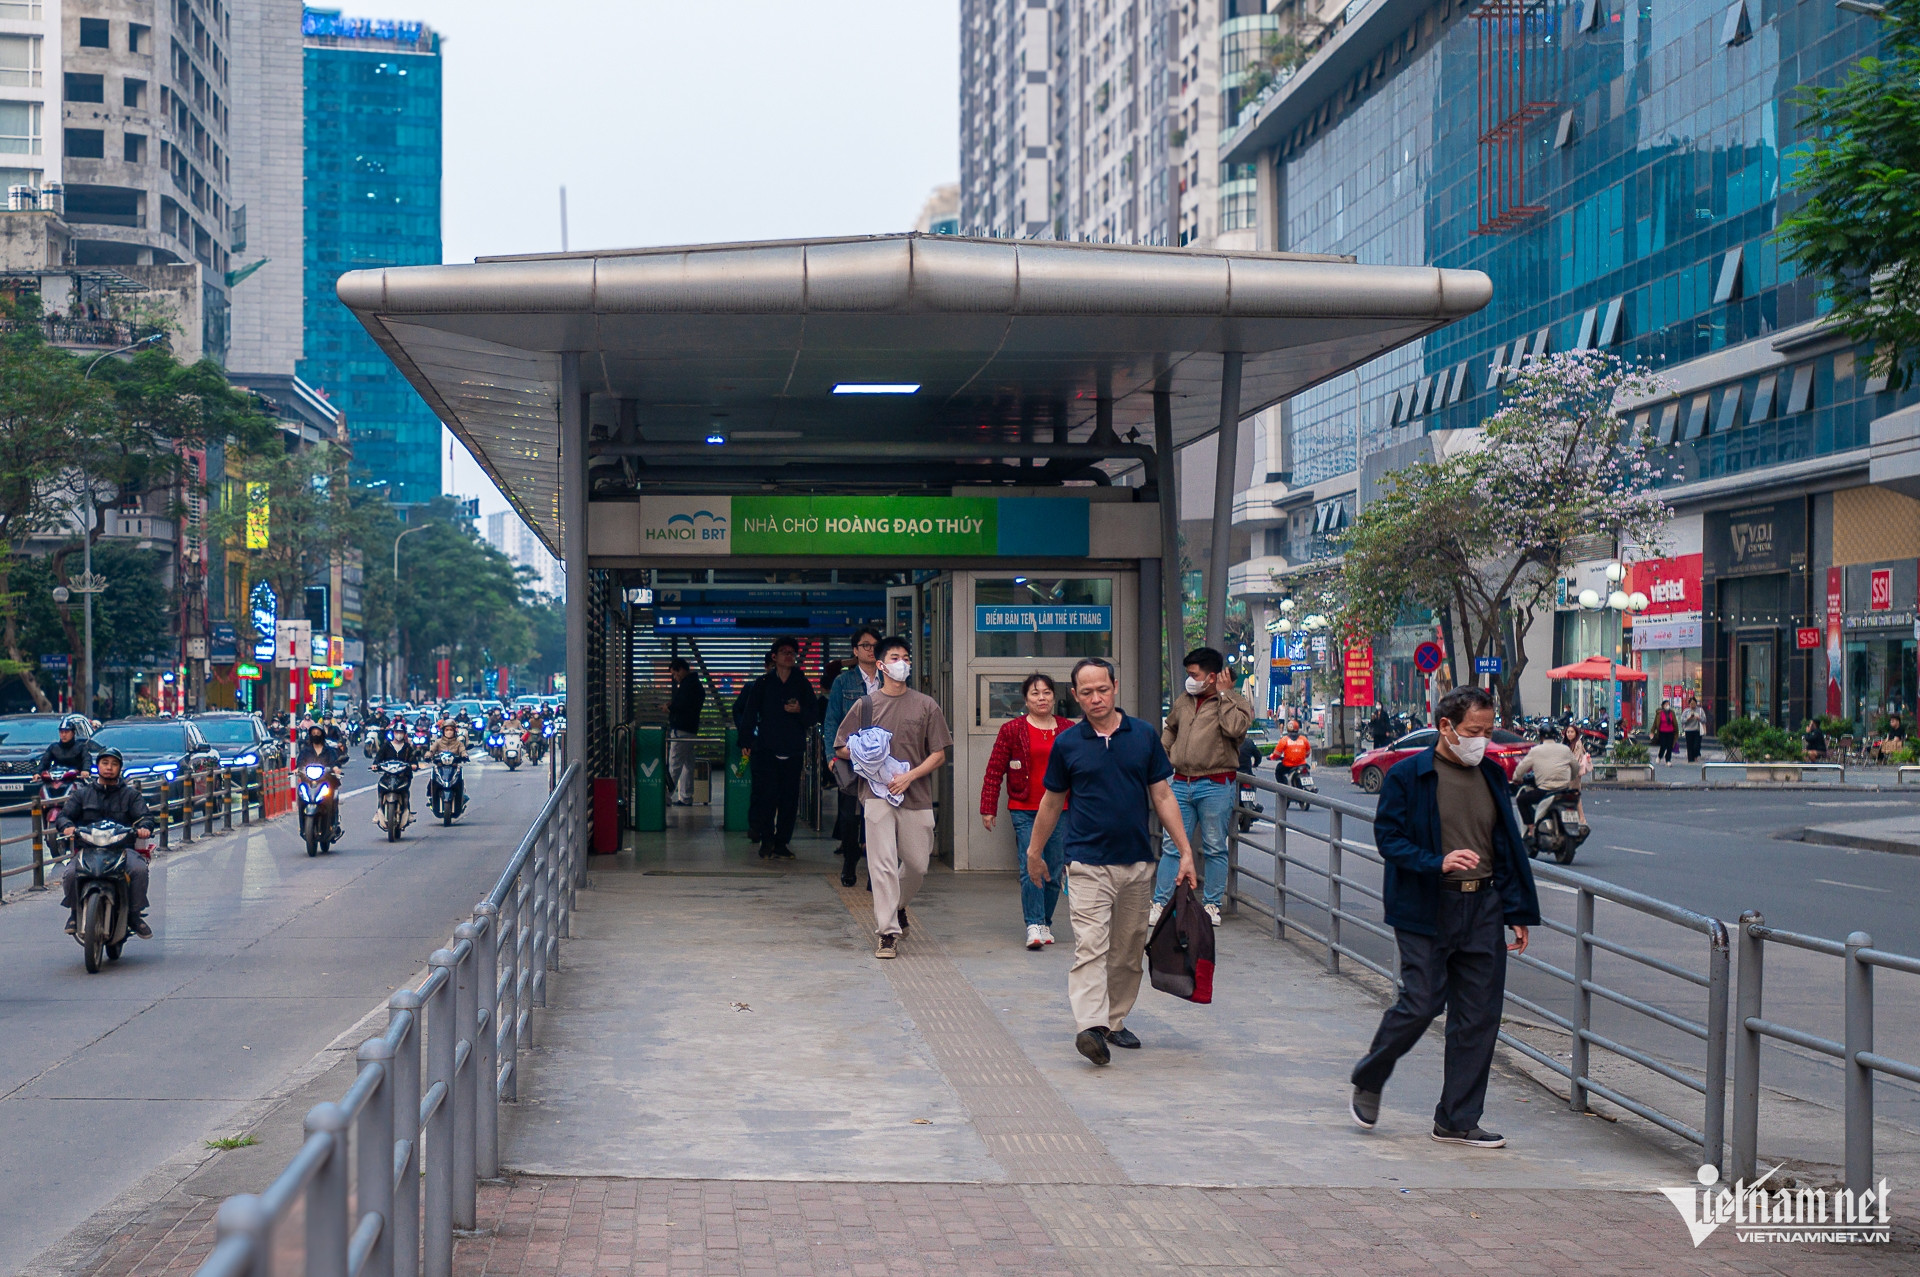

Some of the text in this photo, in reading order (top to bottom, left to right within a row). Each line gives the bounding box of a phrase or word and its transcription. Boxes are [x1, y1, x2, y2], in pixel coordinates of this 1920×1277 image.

[646, 528, 726, 540] HANOI BRT
[744, 514, 984, 537] NHÀ CHỜ HOÀNG ĐẠO THÚY
[1872, 577, 1889, 604] SSI
[1799, 631, 1819, 645] SSI
